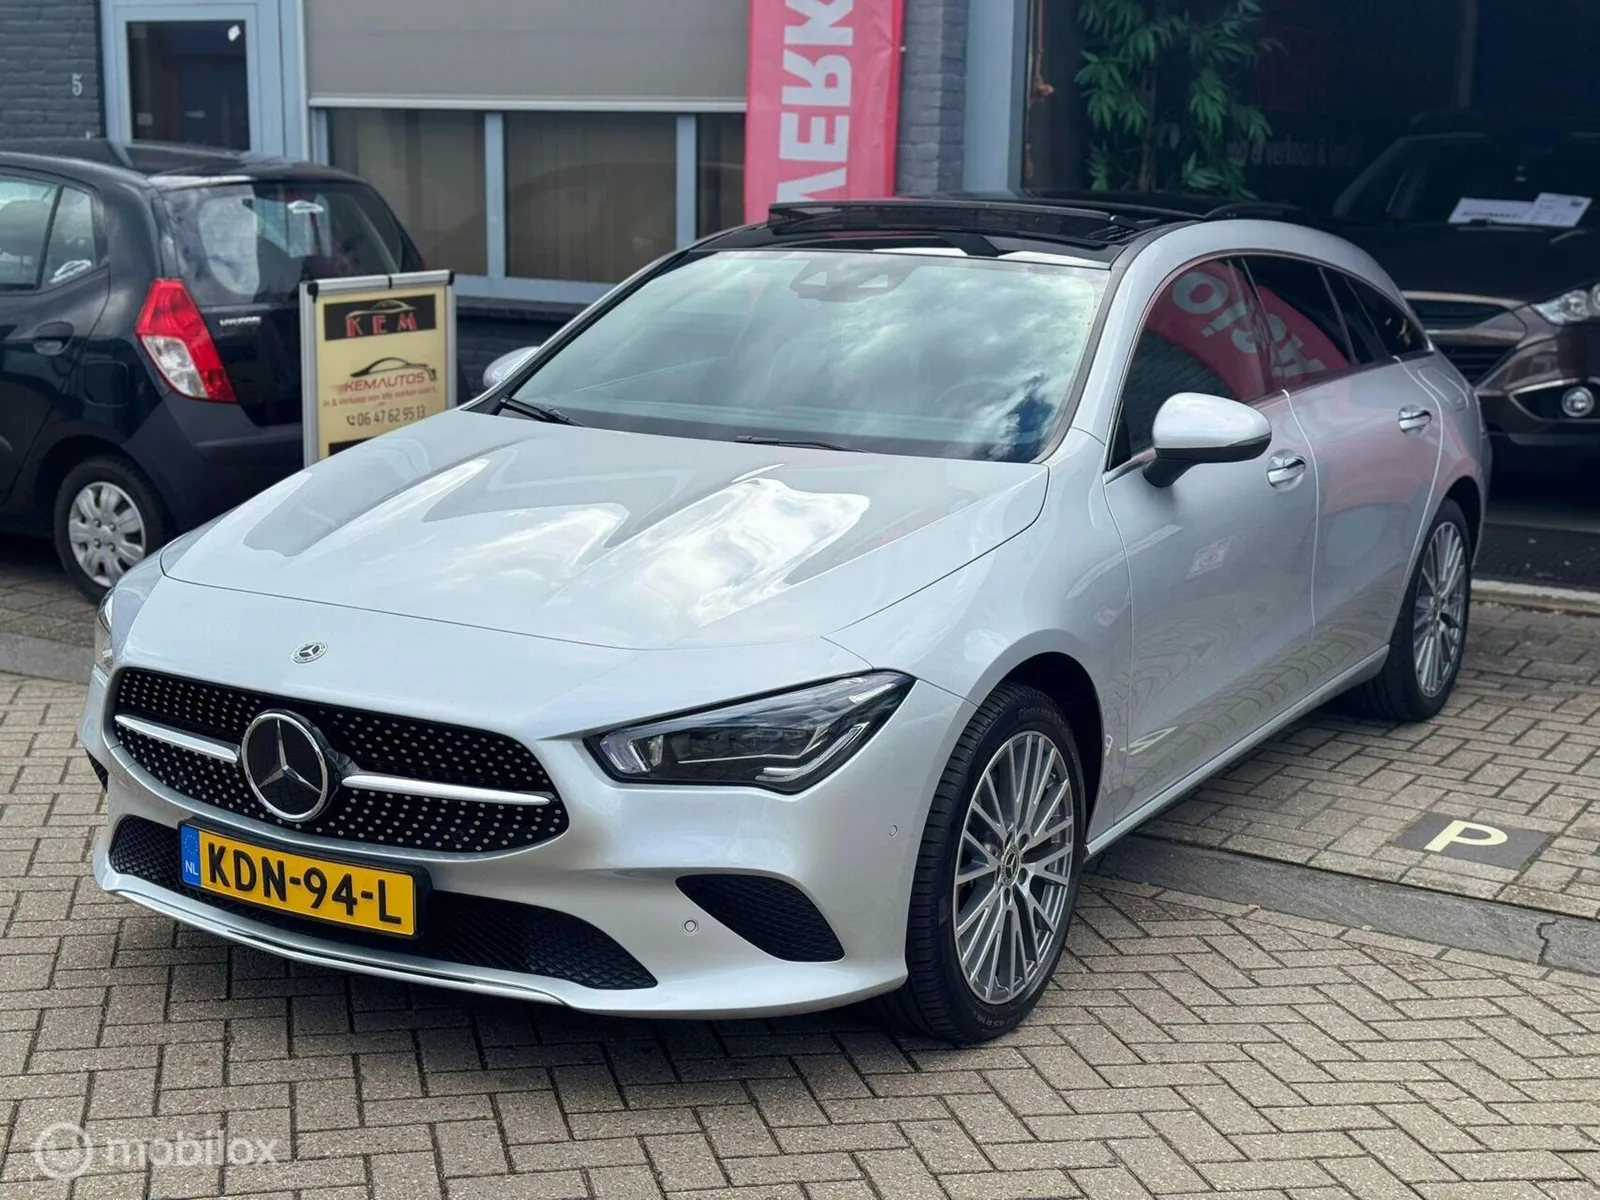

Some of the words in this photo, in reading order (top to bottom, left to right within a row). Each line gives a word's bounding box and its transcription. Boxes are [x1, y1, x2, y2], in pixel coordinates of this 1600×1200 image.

[71, 74, 83, 96] 5
[346, 312, 418, 339] KEM
[345, 372, 425, 392] KEMAUTOS
[357, 412, 371, 427] 06
[373, 409, 386, 424] 47
[388, 408, 400, 422] 62
[1424, 819, 1508, 853] P
[185, 860, 199, 876] NL
[207, 842, 402, 925] KDN-94-L
